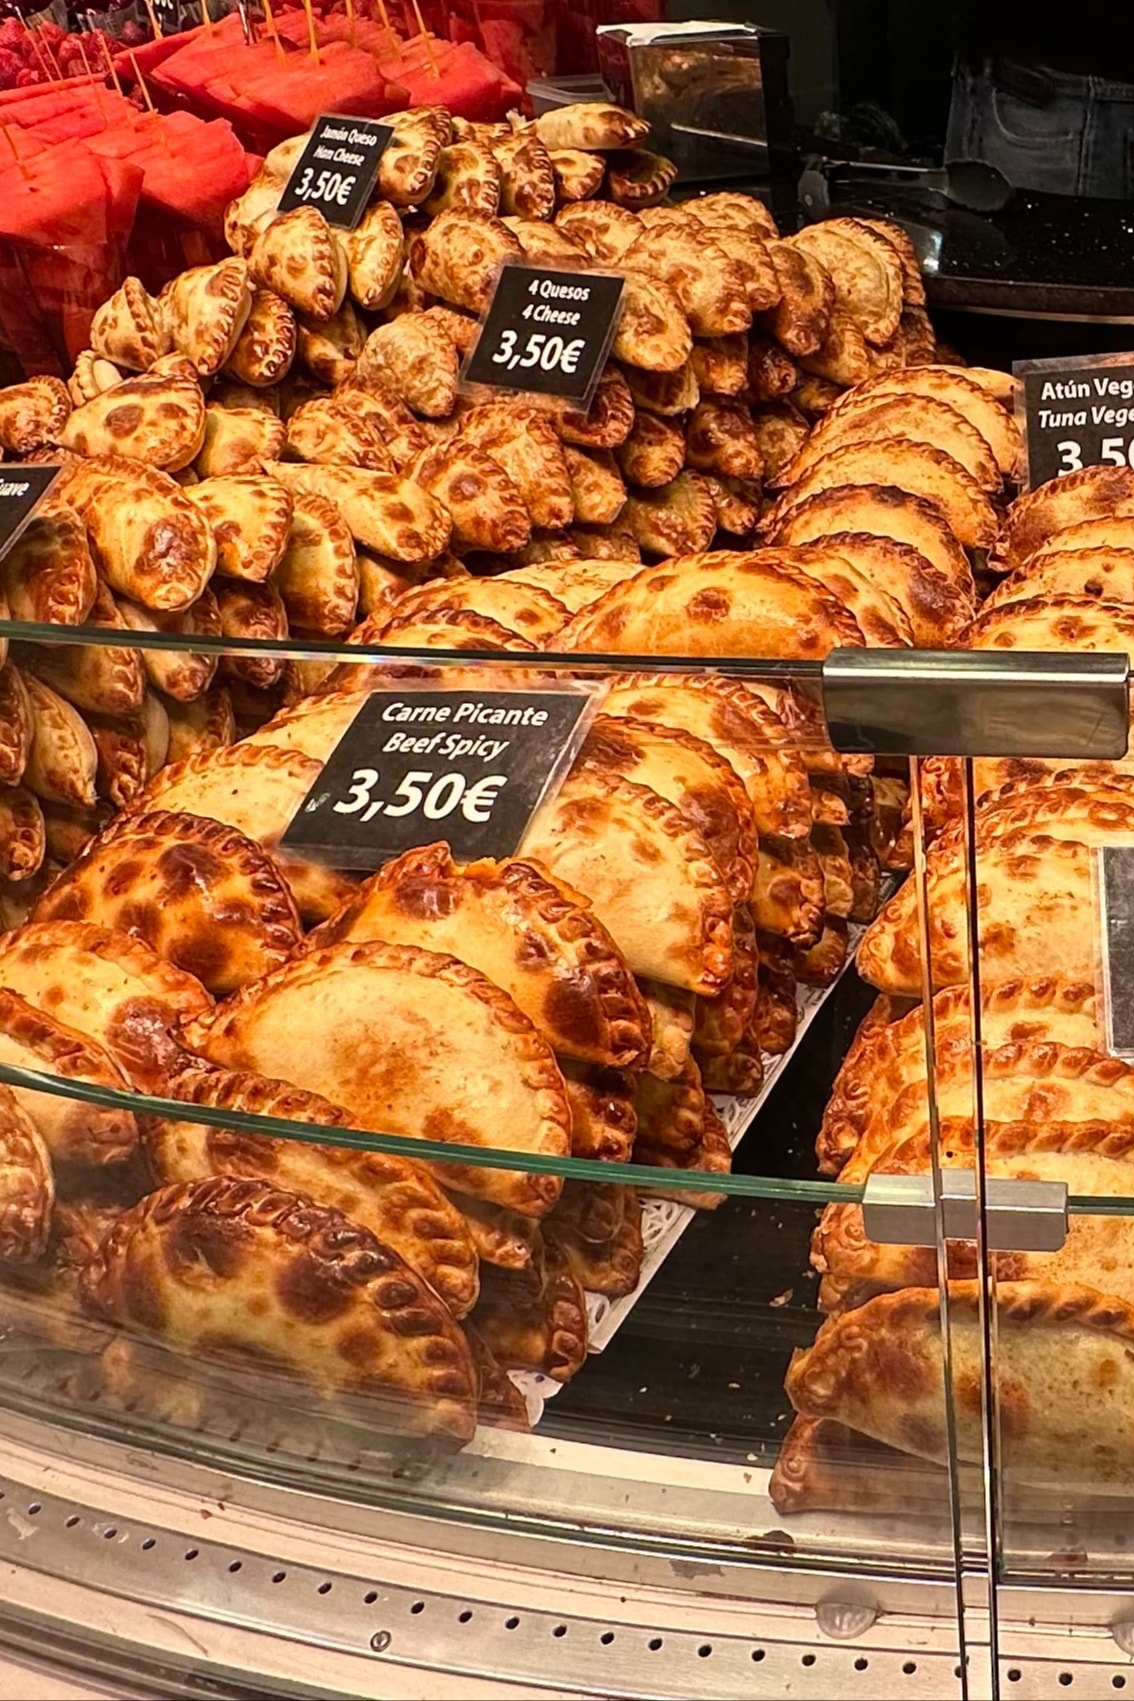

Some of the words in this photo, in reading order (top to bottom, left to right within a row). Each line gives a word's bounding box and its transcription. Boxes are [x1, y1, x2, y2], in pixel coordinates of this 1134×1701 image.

[348, 129, 377, 146] Queso
[333, 148, 365, 166] Cheese
[294, 167, 356, 206] 3,50€
[528, 280, 539, 295] 4
[540, 280, 590, 301] Quesos
[522, 304, 534, 319] 4
[533, 305, 581, 326] Cheese
[492, 330, 586, 373] 3,50€
[1041, 379, 1090, 400] Atún
[1038, 410, 1087, 428] Tuna
[0, 478, 30, 496] uave
[382, 703, 452, 723] Carne
[453, 703, 549, 726] Picante
[382, 732, 447, 753] Beef
[439, 734, 510, 762] Spicy
[333, 769, 508, 823] 3,50€
